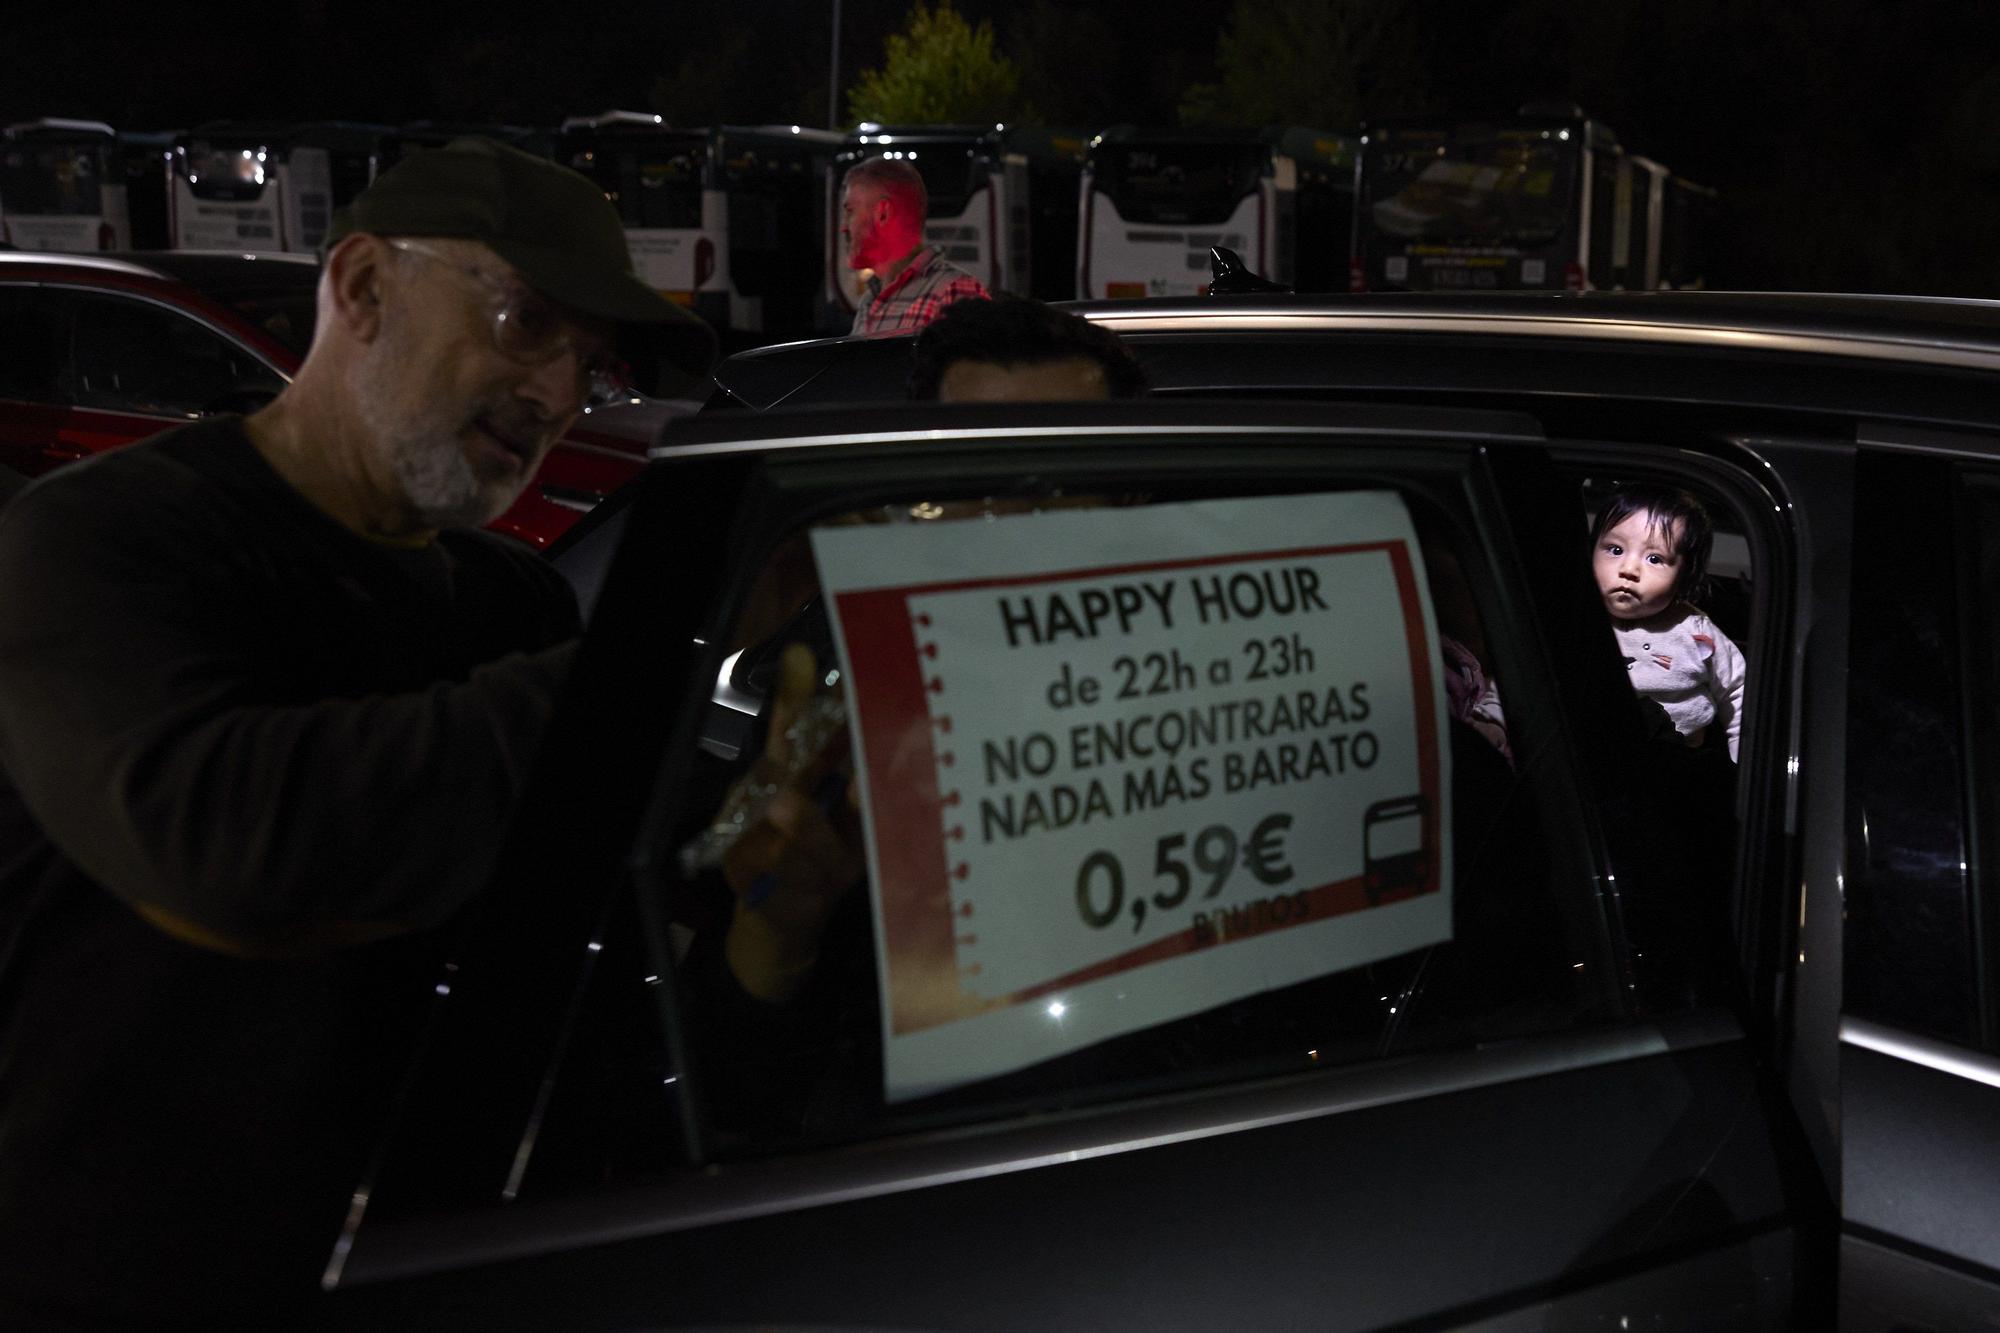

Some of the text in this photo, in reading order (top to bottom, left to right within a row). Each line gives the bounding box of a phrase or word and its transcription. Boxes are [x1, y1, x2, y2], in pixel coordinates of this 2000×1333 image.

[999, 567, 1328, 646] HAPPY HOUR
[1047, 634, 1315, 709] de 22h a 23h
[983, 684, 1370, 785] NO ENCONTRARAS
[980, 778, 1114, 843] NADA
[1224, 731, 1379, 794] BARATO
[1077, 813, 1294, 933] 0,59€
